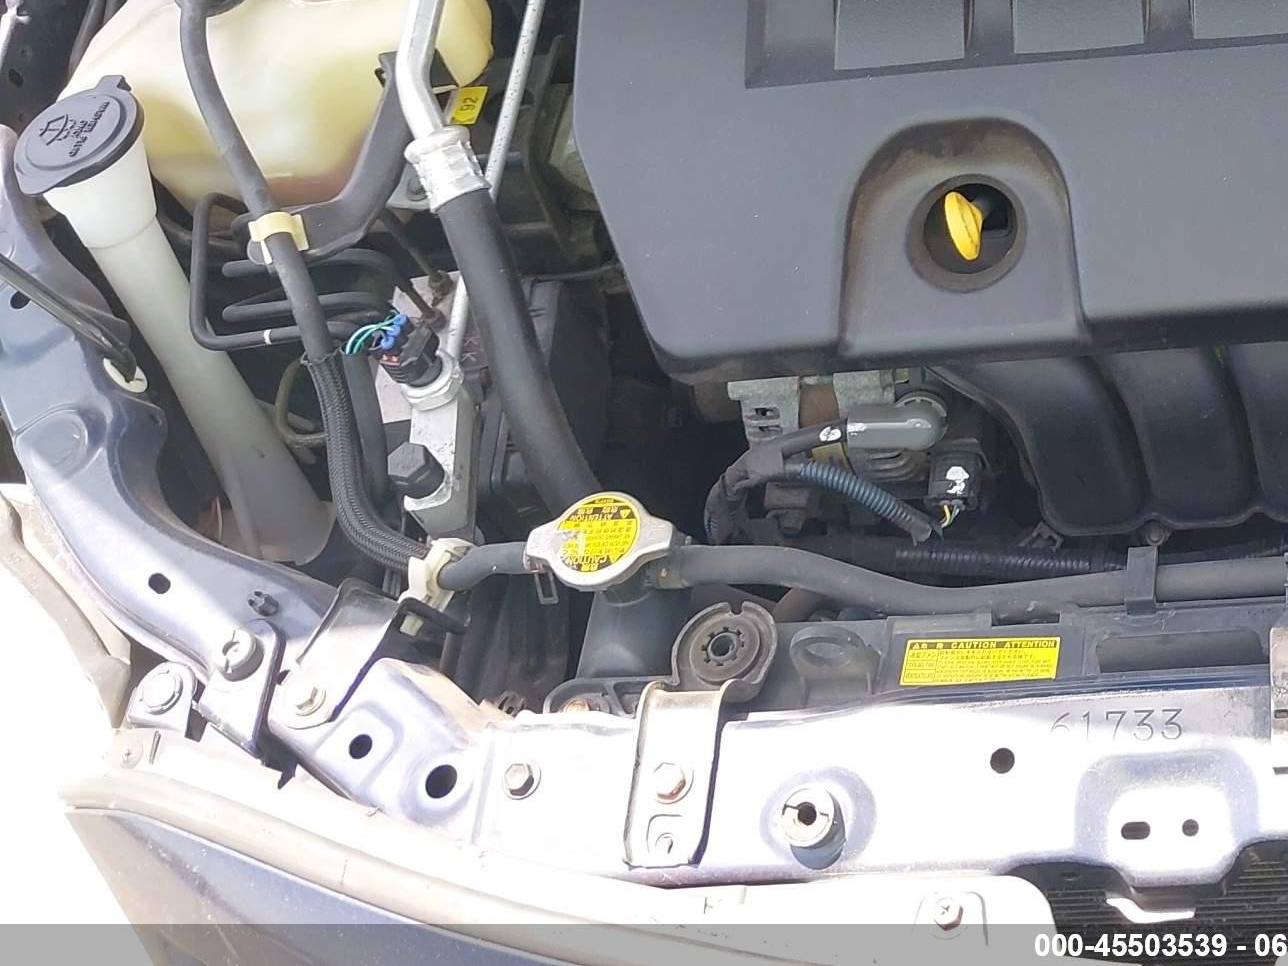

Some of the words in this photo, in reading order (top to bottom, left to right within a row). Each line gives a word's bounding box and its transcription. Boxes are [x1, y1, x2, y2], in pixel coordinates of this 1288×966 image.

[460, 97, 479, 112] 92
[570, 513, 614, 522] ATTENTION
[567, 556, 607, 564] CAUTION
[1004, 640, 1055, 648] ATTENTION
[1050, 708, 1183, 742] 61733
